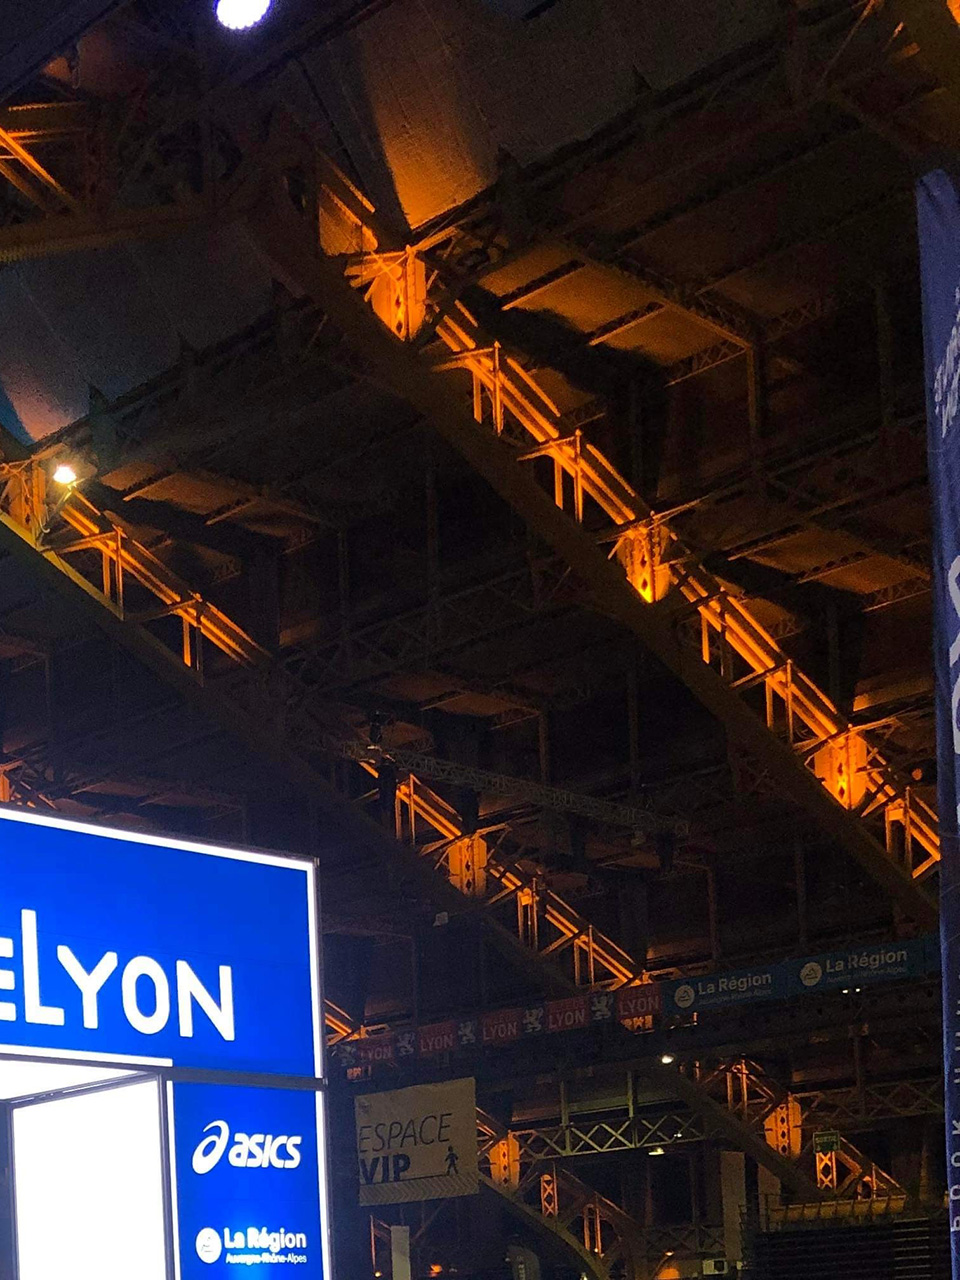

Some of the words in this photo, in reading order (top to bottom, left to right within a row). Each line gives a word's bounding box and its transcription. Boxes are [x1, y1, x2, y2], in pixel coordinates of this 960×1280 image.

[848, 949, 908, 970] Région
[718, 972, 772, 993] Région
[482, 1022, 518, 1041] LYON
[547, 1011, 585, 1028] LYON
[358, 1112, 453, 1153] ESPACE
[229, 1133, 301, 1168] asics
[359, 1153, 411, 1186] VIP
[224, 1226, 246, 1249] La
[246, 1226, 307, 1253] Région
